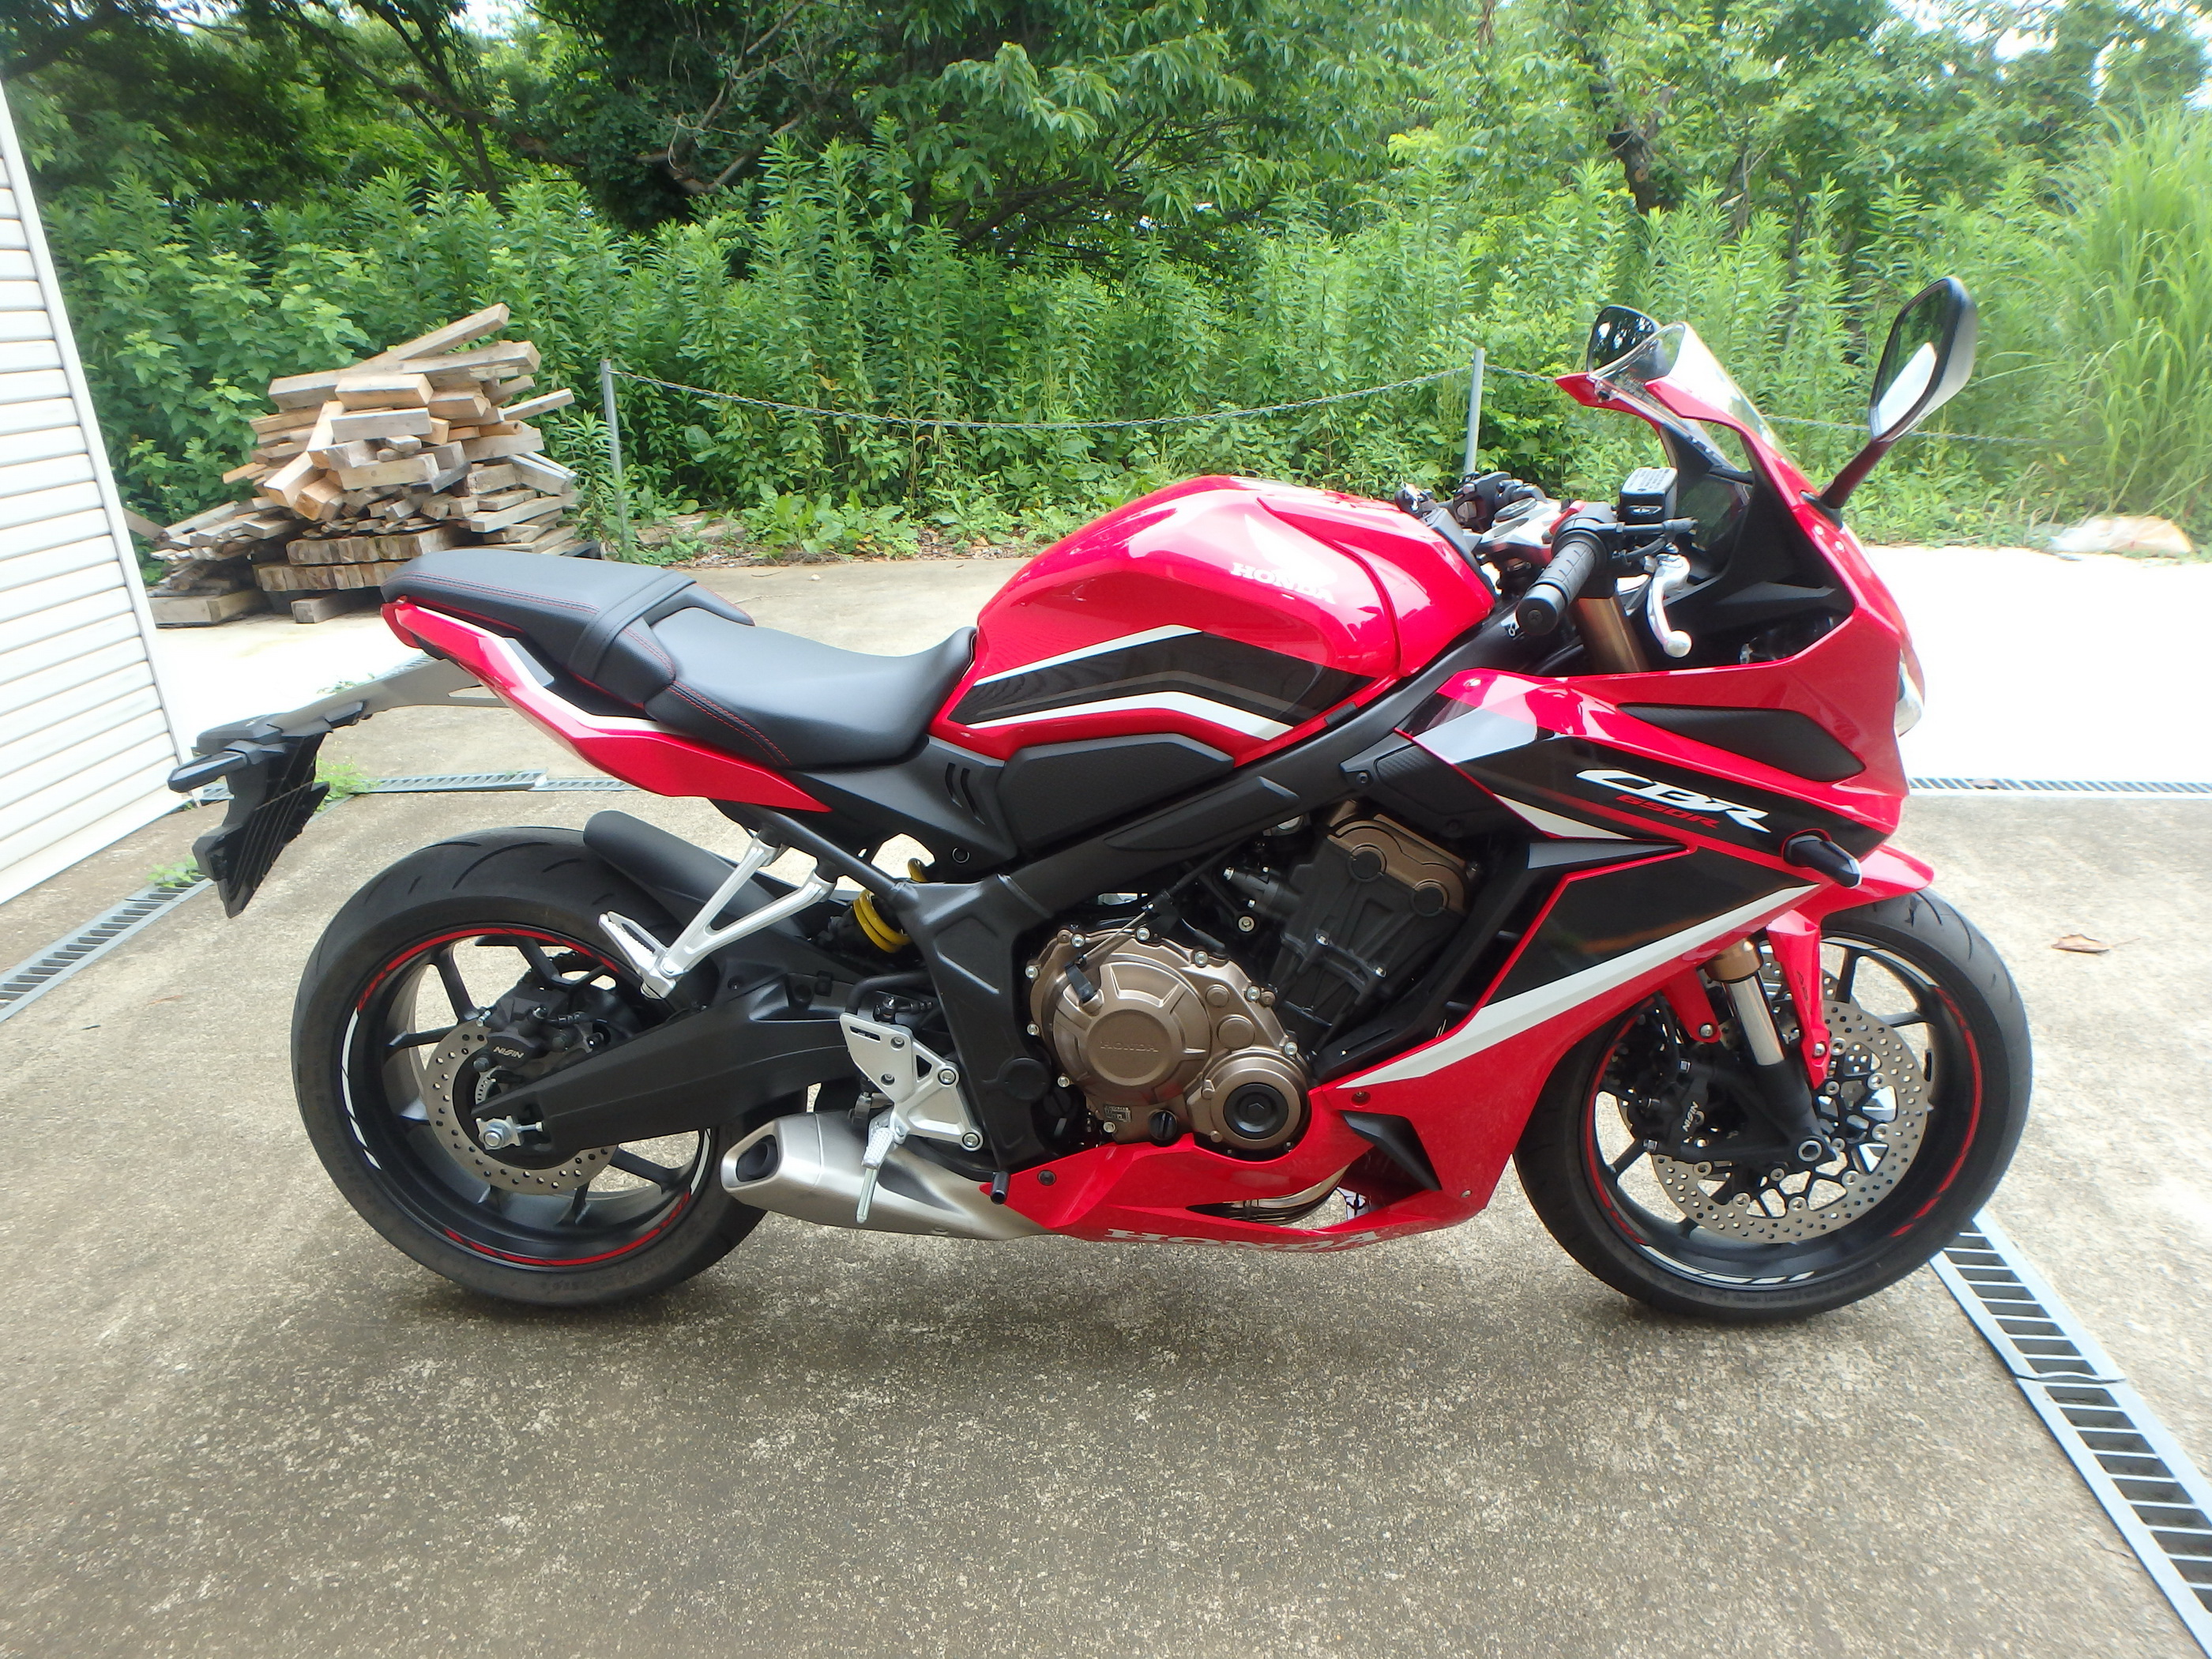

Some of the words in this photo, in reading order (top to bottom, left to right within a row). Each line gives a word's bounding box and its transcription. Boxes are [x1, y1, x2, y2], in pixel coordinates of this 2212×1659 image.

[1575, 769, 1771, 833] CBR
[1616, 795, 1720, 829] 650R
[1100, 1041, 1159, 1053] HONDA
[1104, 1228, 1382, 1251] HONDA
